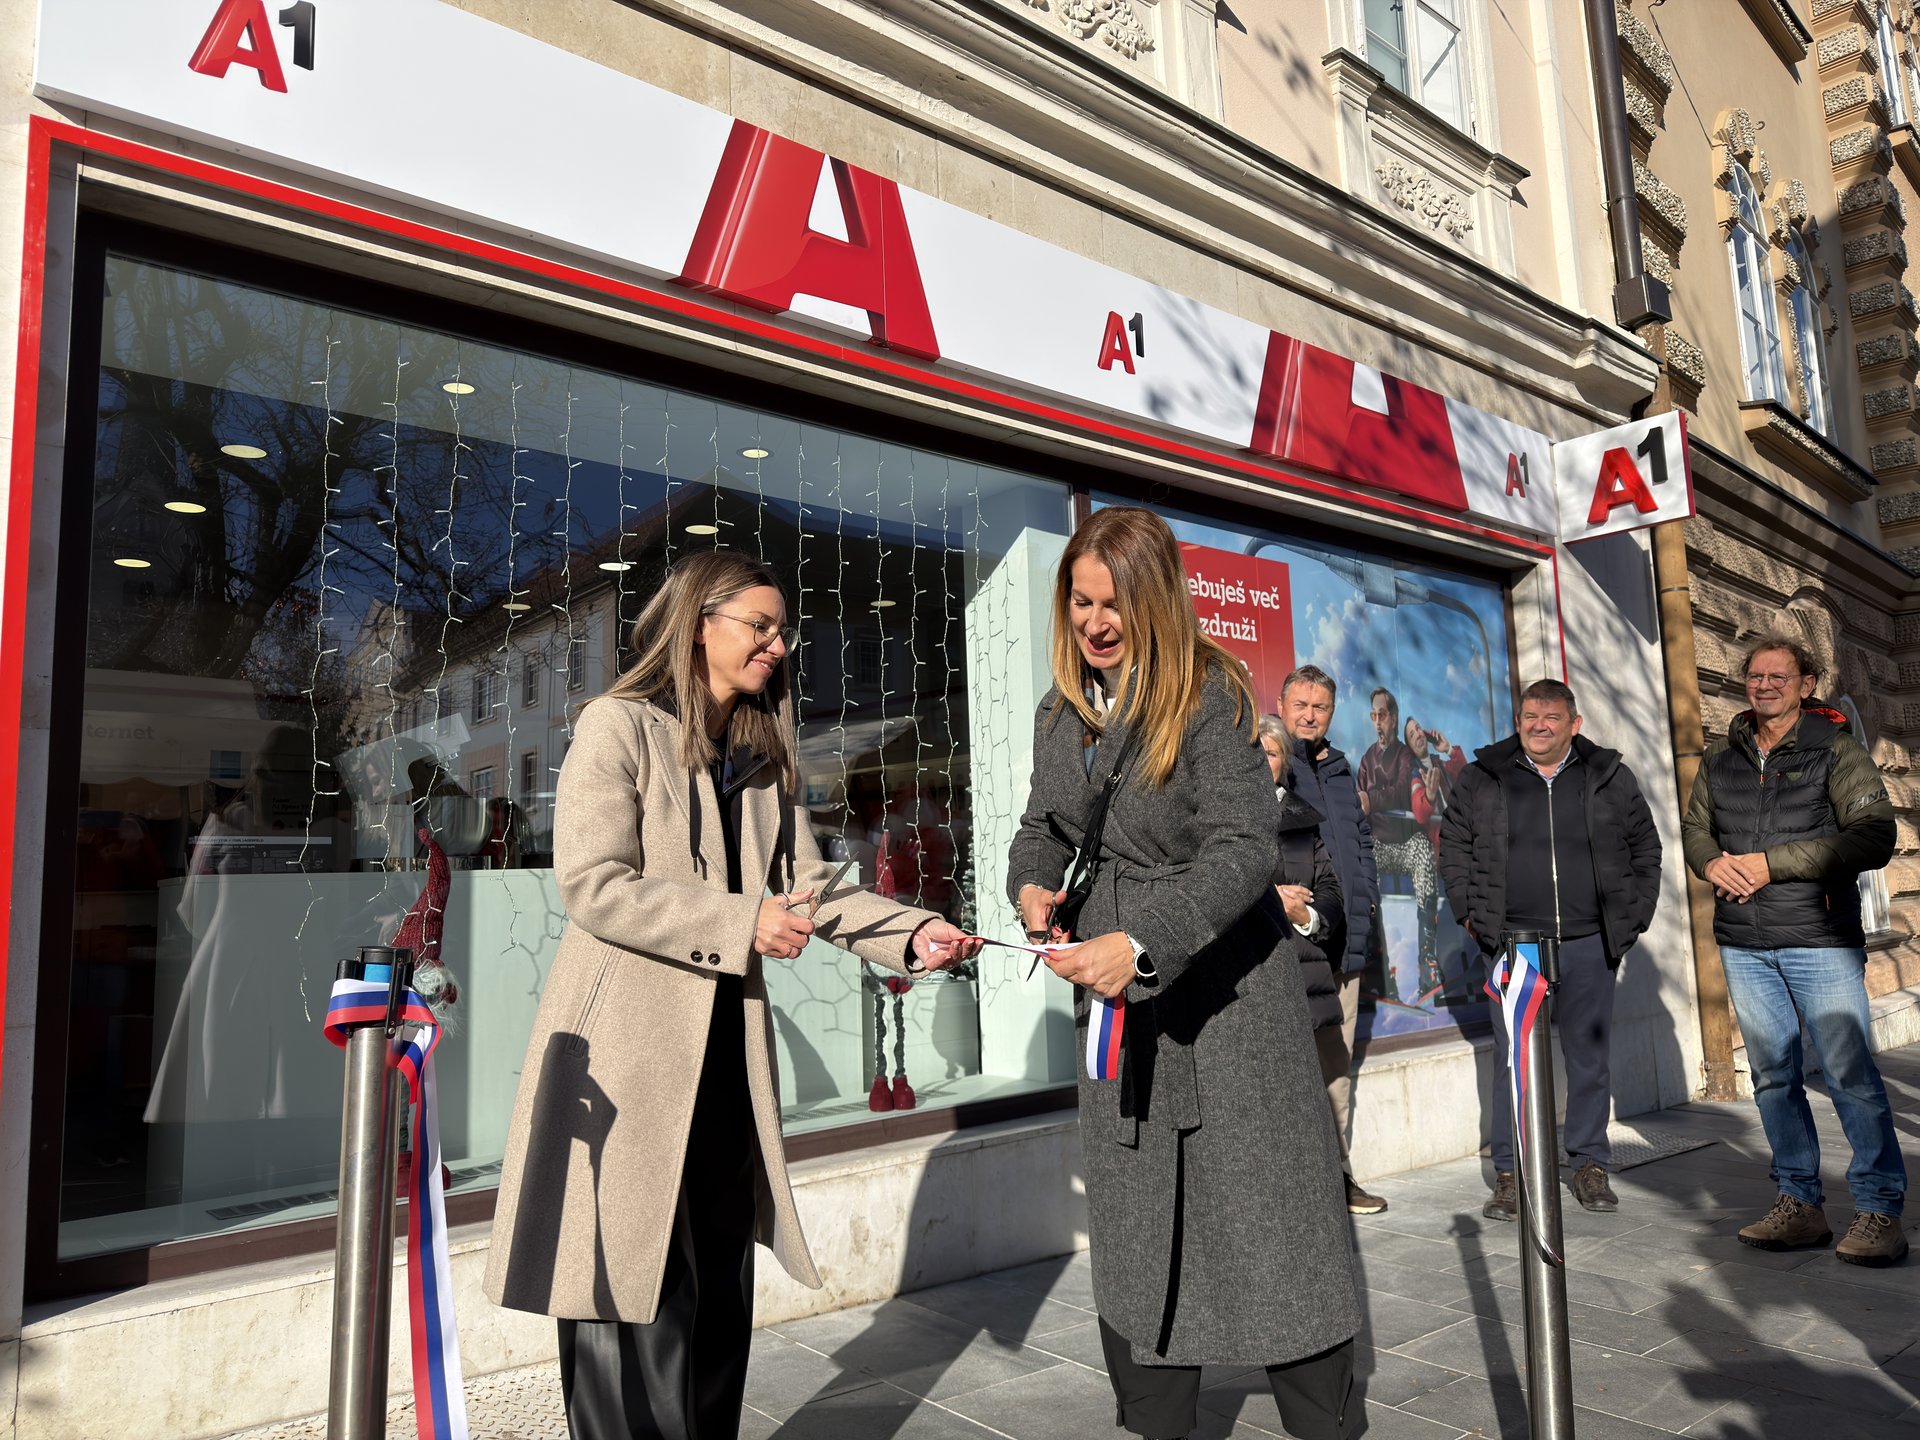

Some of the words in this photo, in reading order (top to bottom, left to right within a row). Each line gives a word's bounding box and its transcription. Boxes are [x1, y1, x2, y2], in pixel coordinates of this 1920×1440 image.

[187, 0, 316, 94] A1
[1097, 310, 1145, 375] A1
[1505, 451, 1530, 498] A1
[1586, 426, 1669, 525] A1
[1187, 572, 1246, 607] ebuješ
[1249, 586, 1281, 610] več
[1199, 612, 1258, 642] združi
[86, 723, 155, 741] ternet
